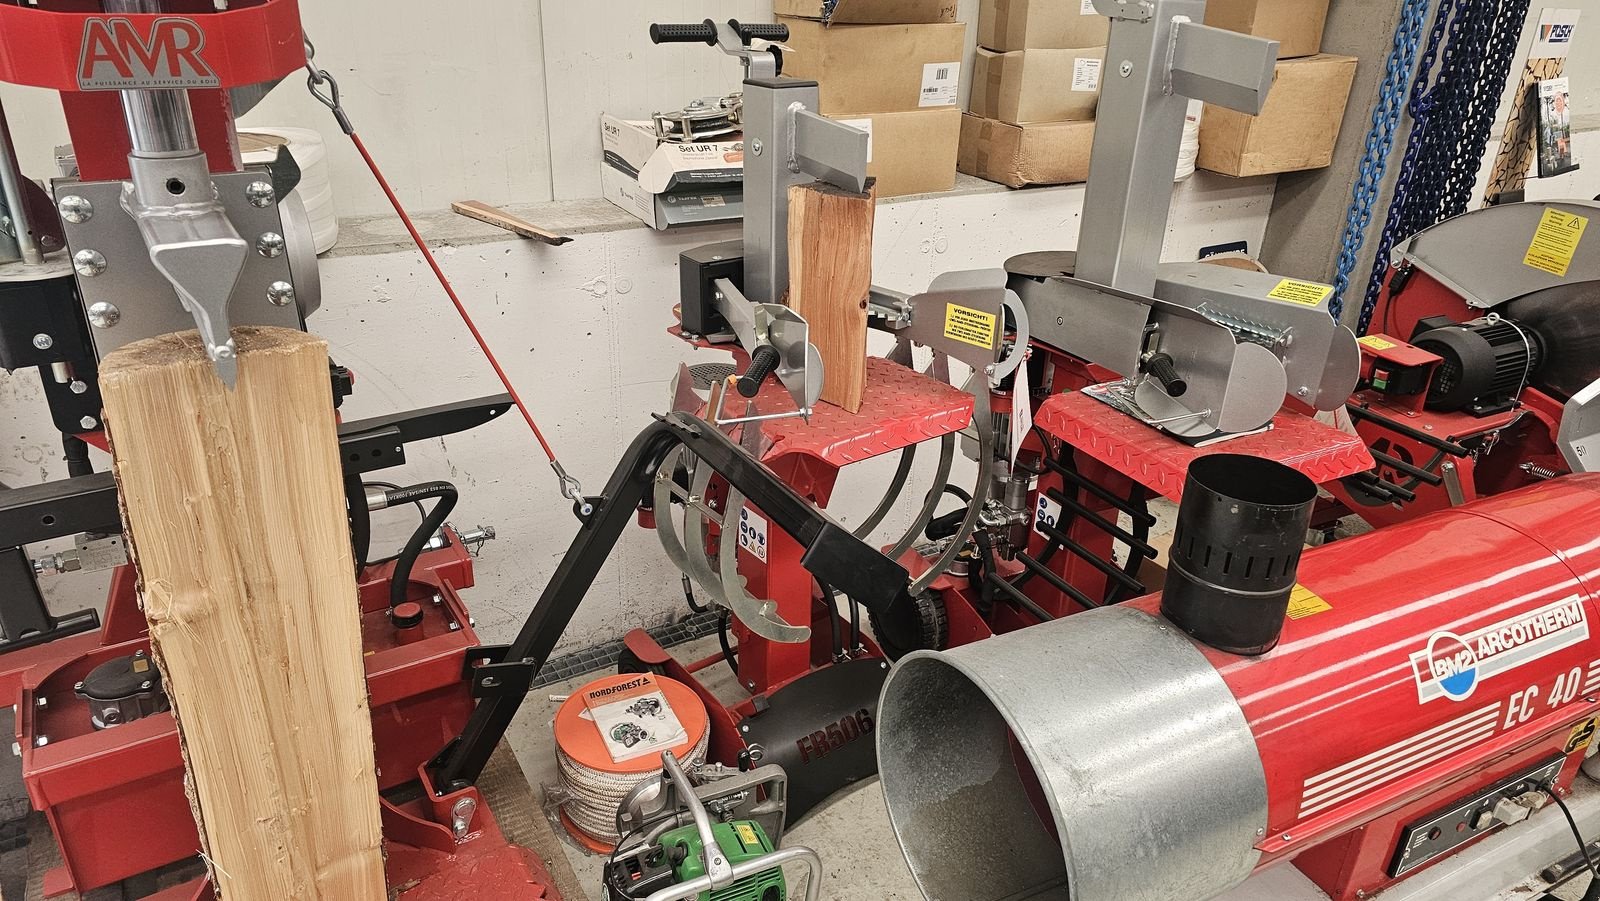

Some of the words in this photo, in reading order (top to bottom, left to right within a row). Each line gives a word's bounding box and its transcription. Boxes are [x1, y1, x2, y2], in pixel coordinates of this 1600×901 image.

[82, 21, 211, 79] AMR
[678, 145, 695, 153] Set
[696, 144, 711, 152] UR
[712, 144, 719, 152] 7
[953, 307, 988, 321] VORSICHT!
[1478, 602, 1582, 659] ARCOTHERM
[1434, 652, 1474, 678] BM2
[1503, 684, 1539, 731] EC
[1547, 666, 1582, 709] 40
[796, 708, 873, 766] FB506
